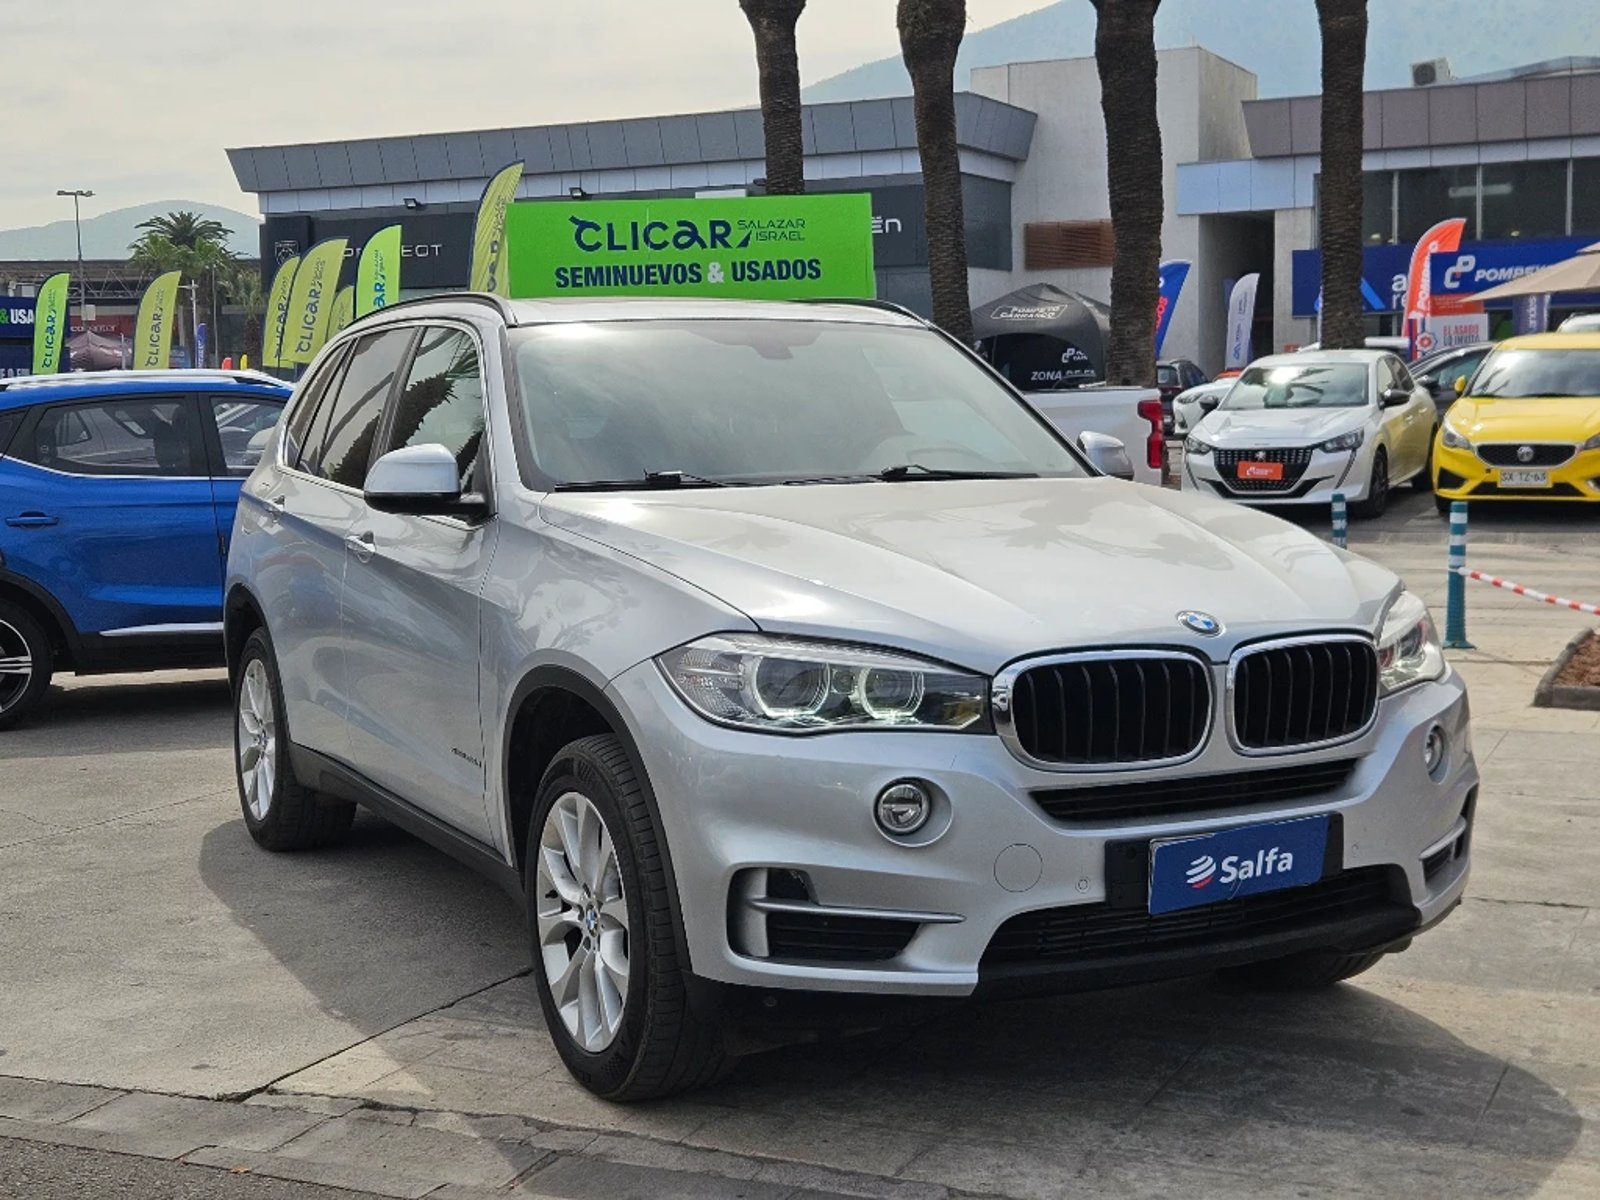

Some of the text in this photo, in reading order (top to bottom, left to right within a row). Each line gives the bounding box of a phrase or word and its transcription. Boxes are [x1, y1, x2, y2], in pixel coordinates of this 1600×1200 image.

[737, 218, 806, 229] SALAZAR
[756, 230, 806, 242] ISRAEL
[554, 258, 822, 289] SEMINUEVOS & USADOS
[10, 308, 34, 325] USA
[1031, 371, 1062, 381] ZONA
[1219, 846, 1294, 884] Salfa
